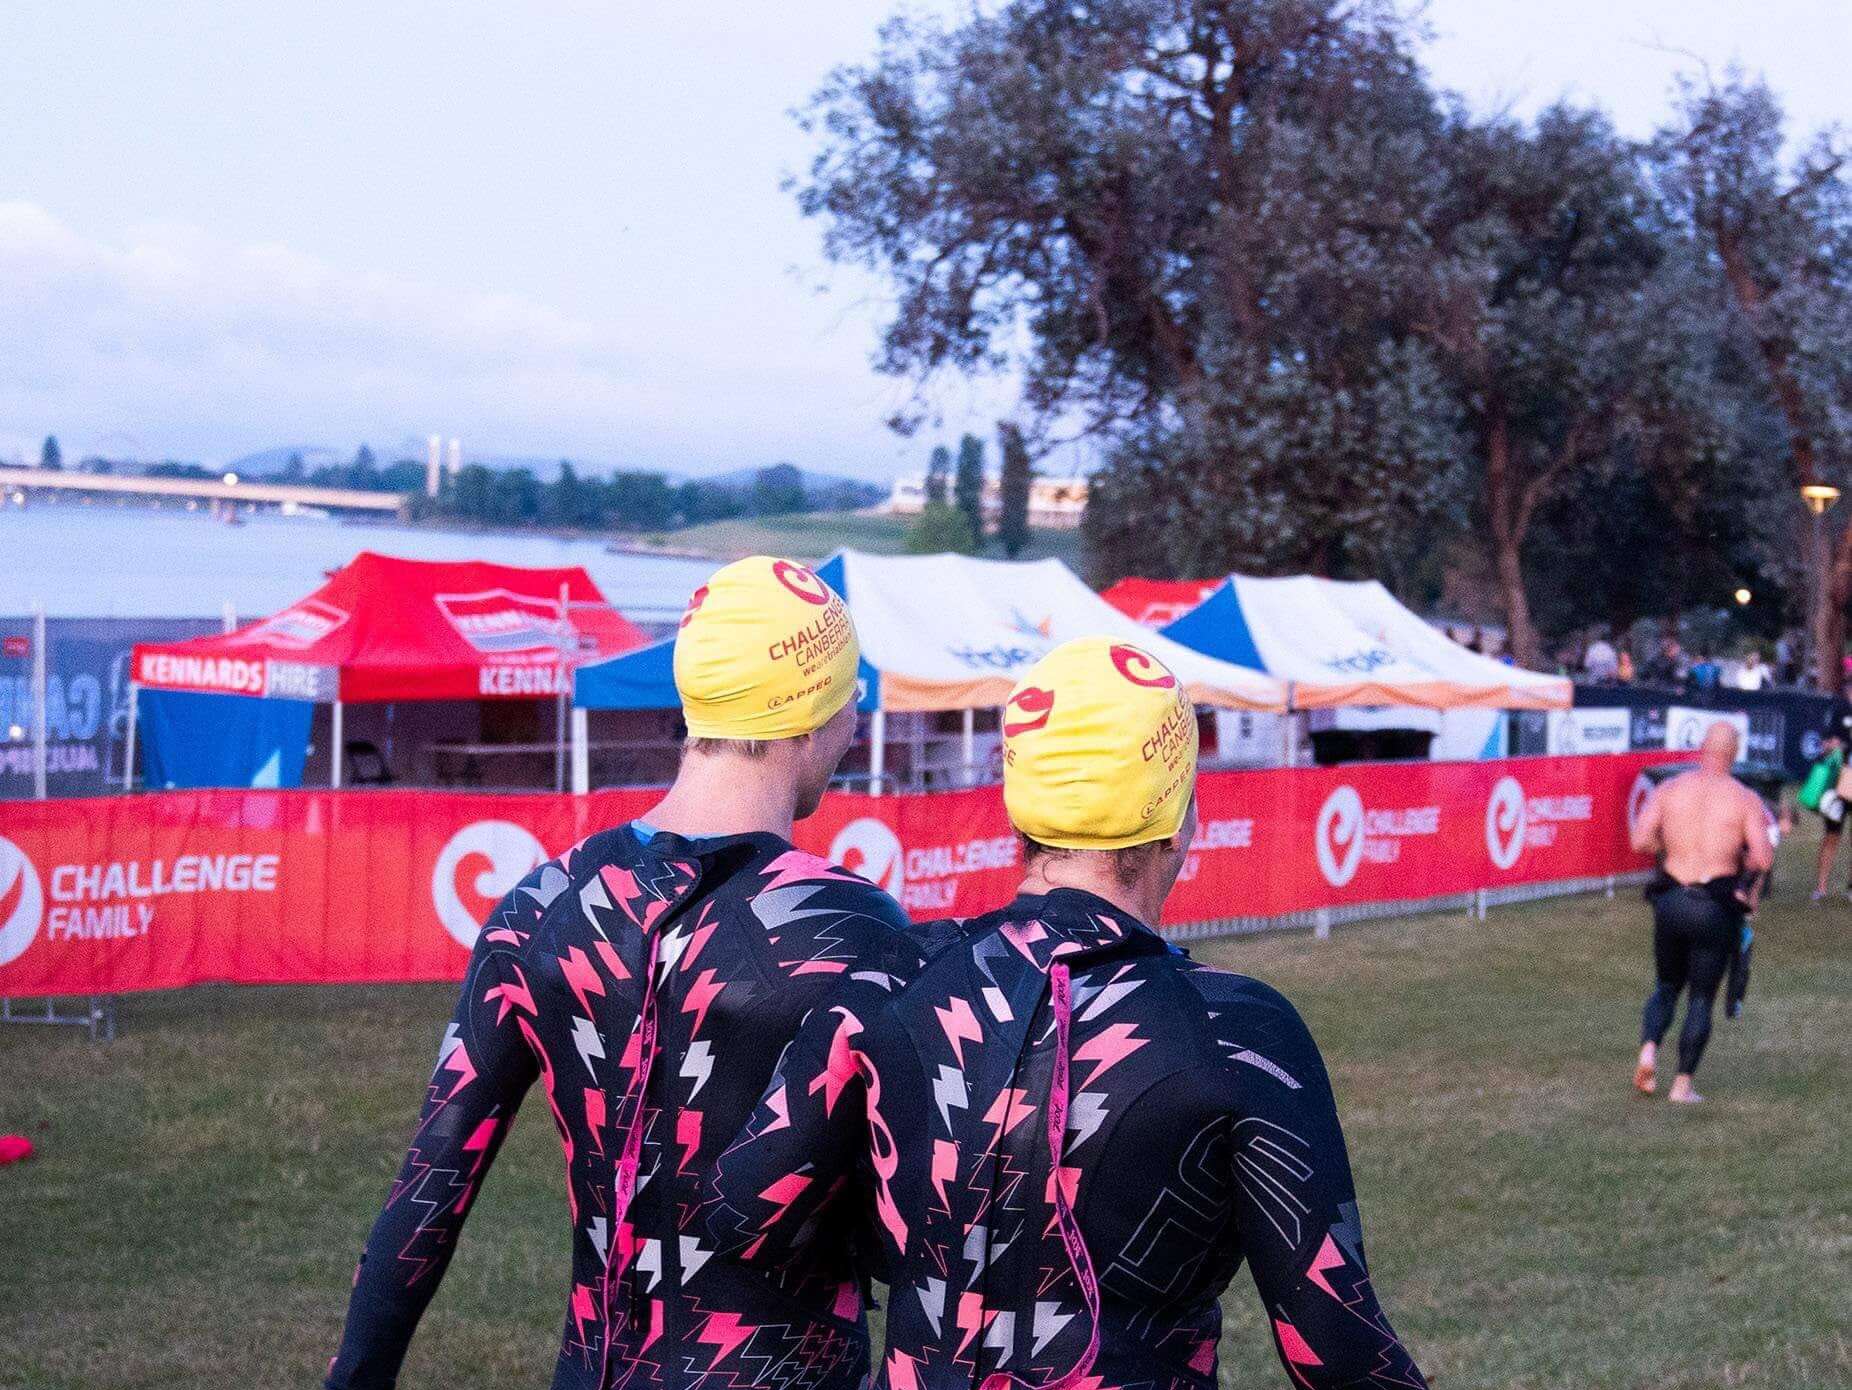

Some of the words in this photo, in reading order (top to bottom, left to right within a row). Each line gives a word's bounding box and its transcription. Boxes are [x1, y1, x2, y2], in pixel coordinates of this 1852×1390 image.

[769, 595, 845, 661] CHALLENG
[142, 654, 262, 692] KENNARDS
[480, 666, 573, 694] KENNA
[51, 854, 280, 901] CHALLENGE
[48, 904, 155, 941] FAMILY
